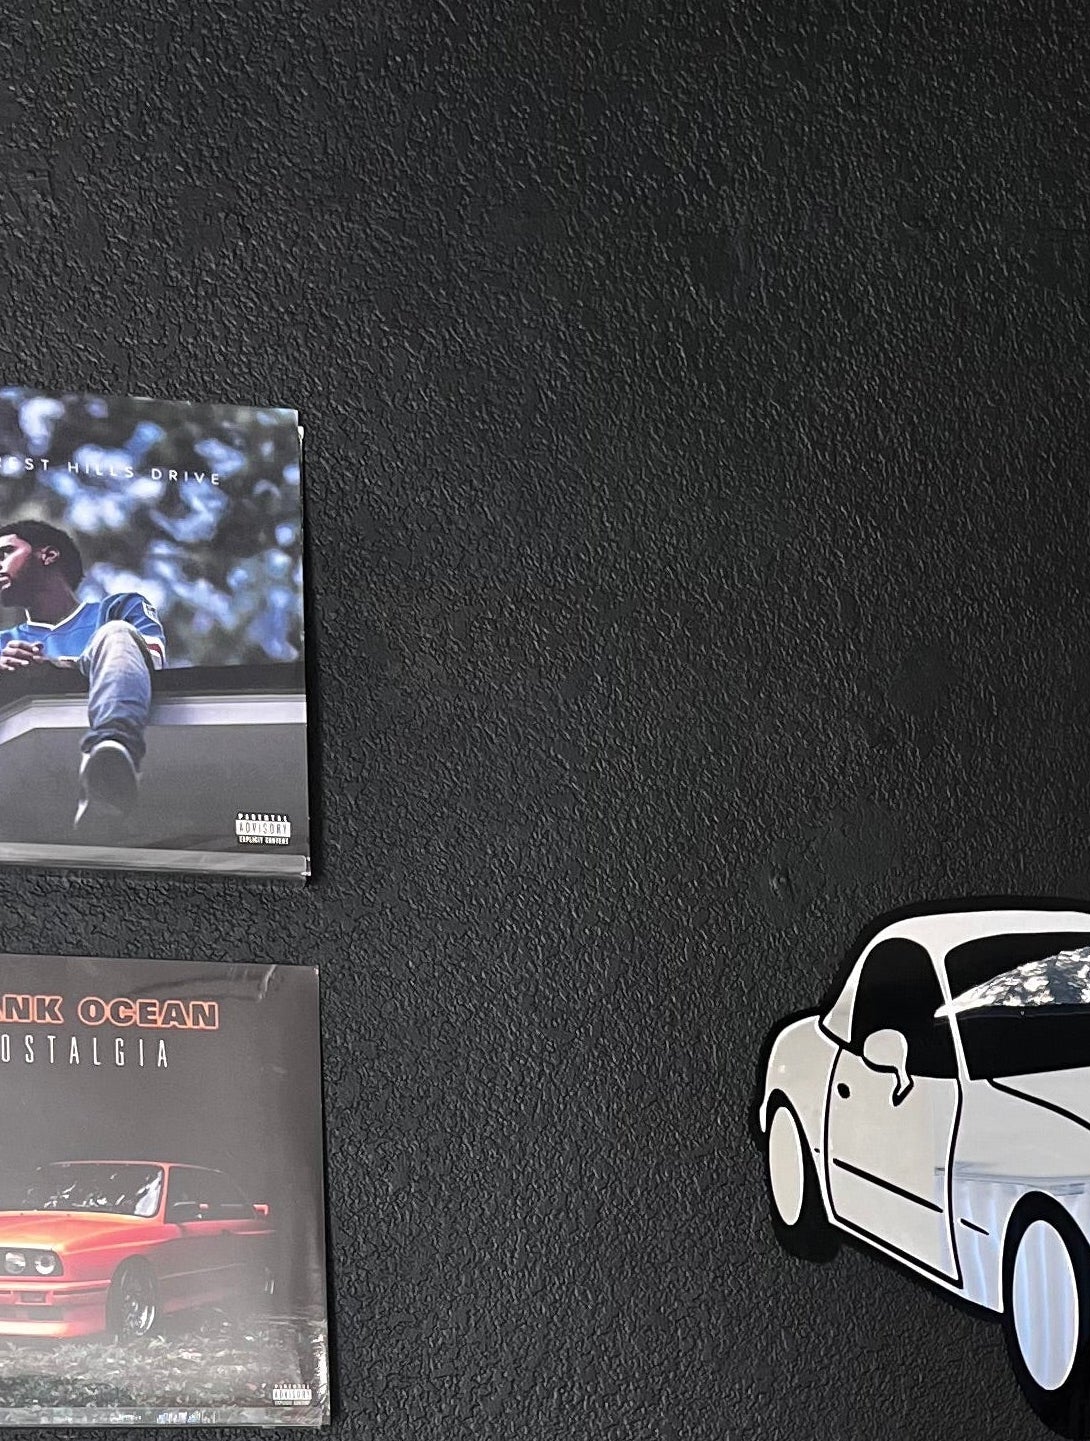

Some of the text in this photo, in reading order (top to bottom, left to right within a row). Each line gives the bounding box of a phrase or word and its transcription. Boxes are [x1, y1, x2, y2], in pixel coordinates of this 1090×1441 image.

[0, 457, 220, 486] EST HILLS DRIVE
[0, 994, 219, 1030] NK OCEAN
[1, 1034, 168, 1069] OSTALGIA
